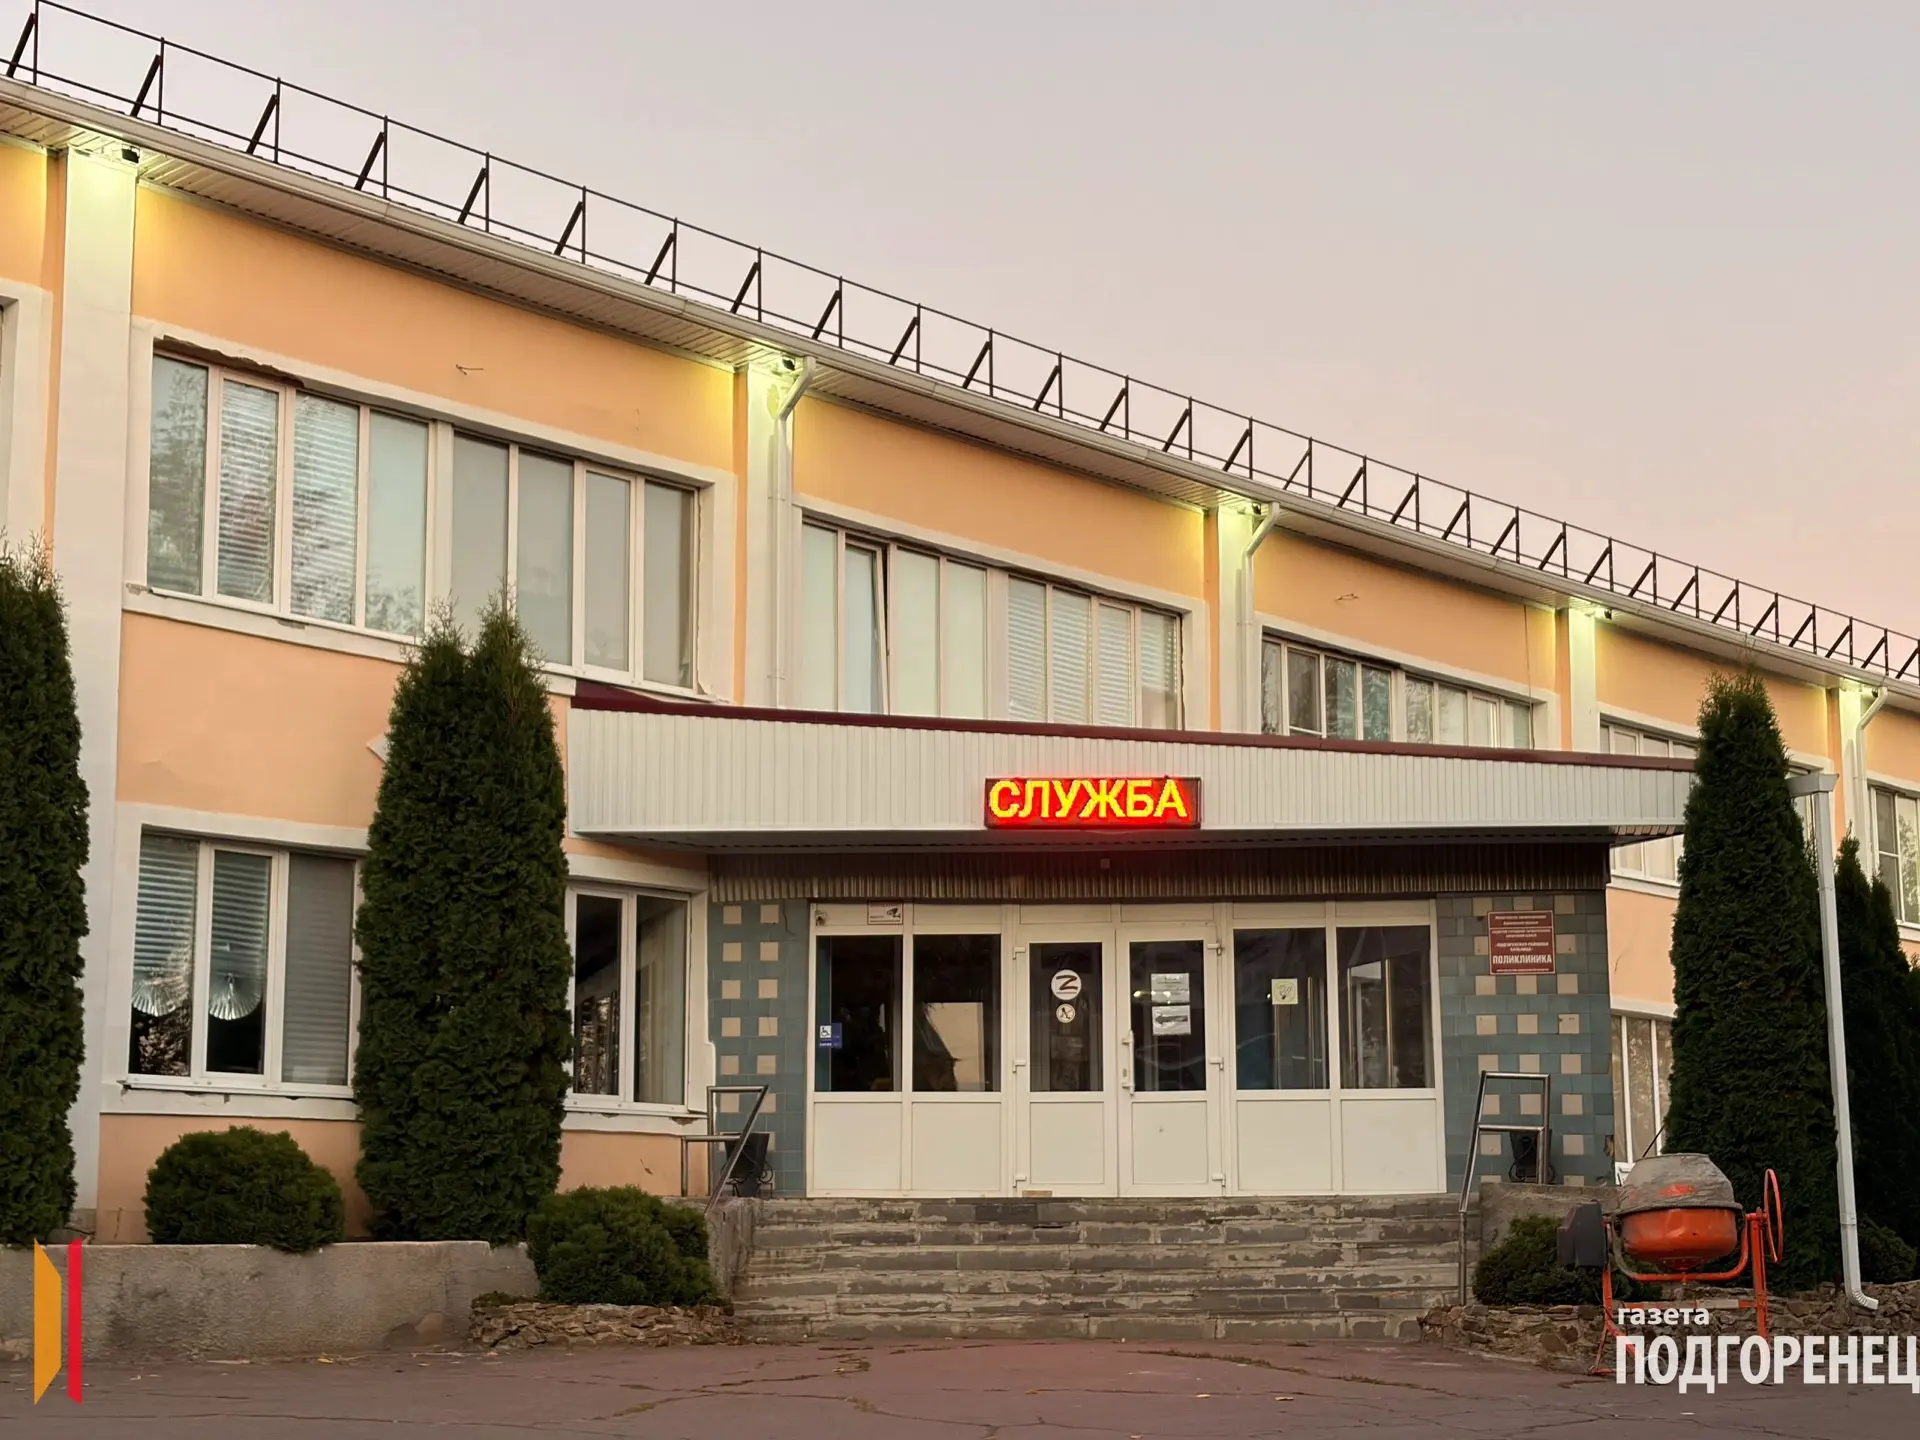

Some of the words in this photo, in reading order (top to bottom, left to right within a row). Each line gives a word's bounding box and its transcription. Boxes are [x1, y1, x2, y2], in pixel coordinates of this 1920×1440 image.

[989, 779, 1188, 818] СЛУЖБА
[1492, 954, 1552, 964] ПОЛИКЛИНИКА
[1055, 974, 1079, 991] Z
